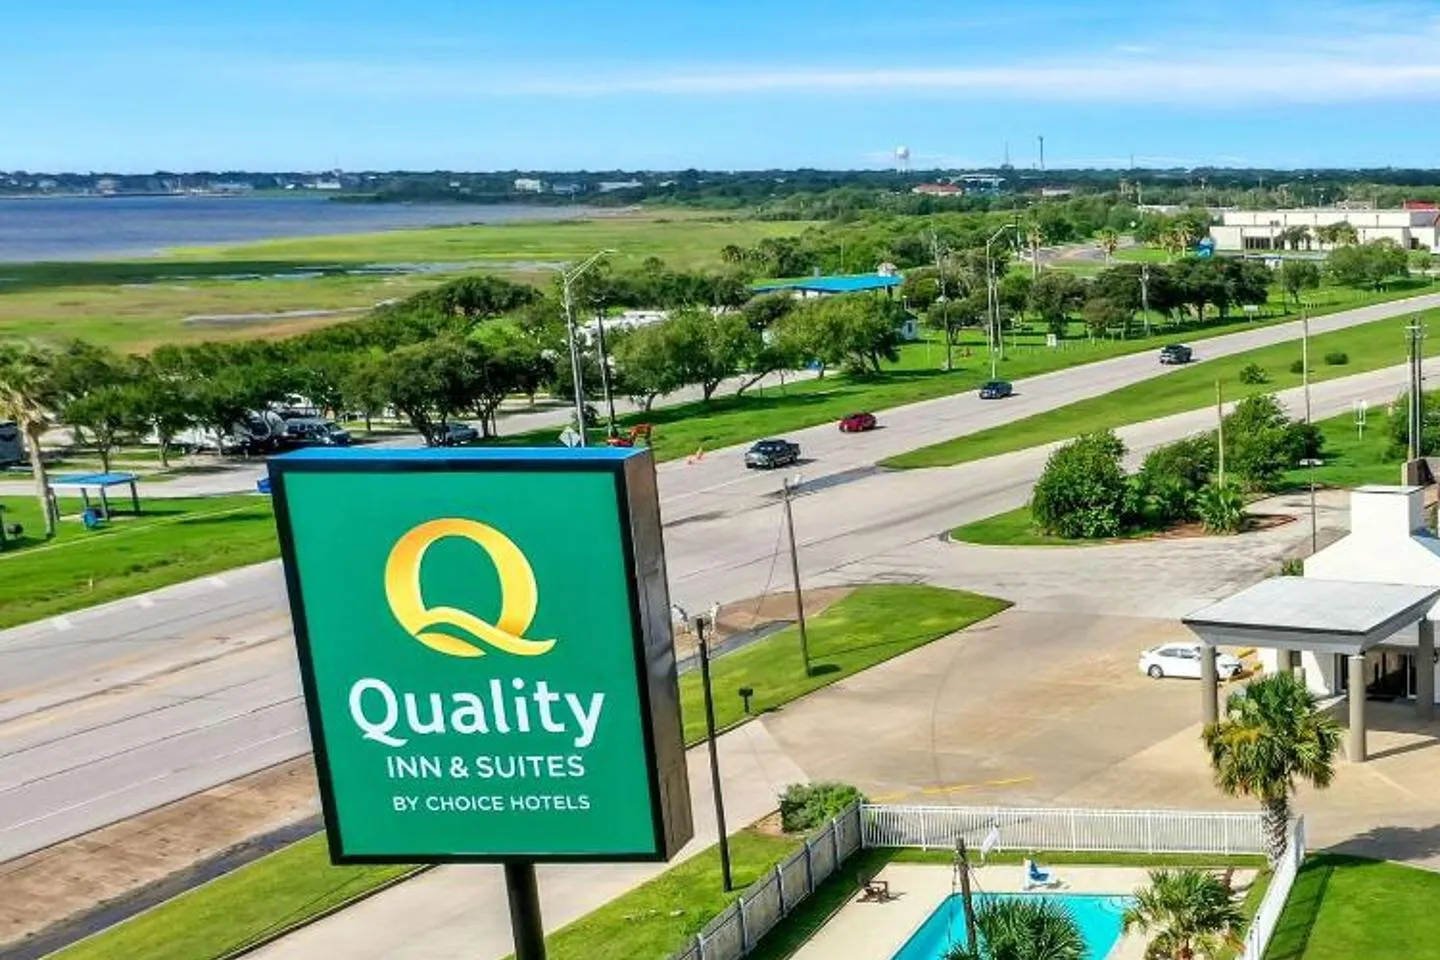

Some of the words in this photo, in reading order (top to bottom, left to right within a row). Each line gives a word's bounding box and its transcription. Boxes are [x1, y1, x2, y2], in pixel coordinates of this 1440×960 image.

[384, 517, 557, 658] Q
[348, 677, 605, 748] Quality
[387, 756, 442, 778] INN
[449, 756, 469, 778] &
[476, 755, 585, 778] SUITES
[393, 796, 418, 811] BY
[426, 796, 503, 811] CHOICE
[510, 795, 590, 810] HOTELS
